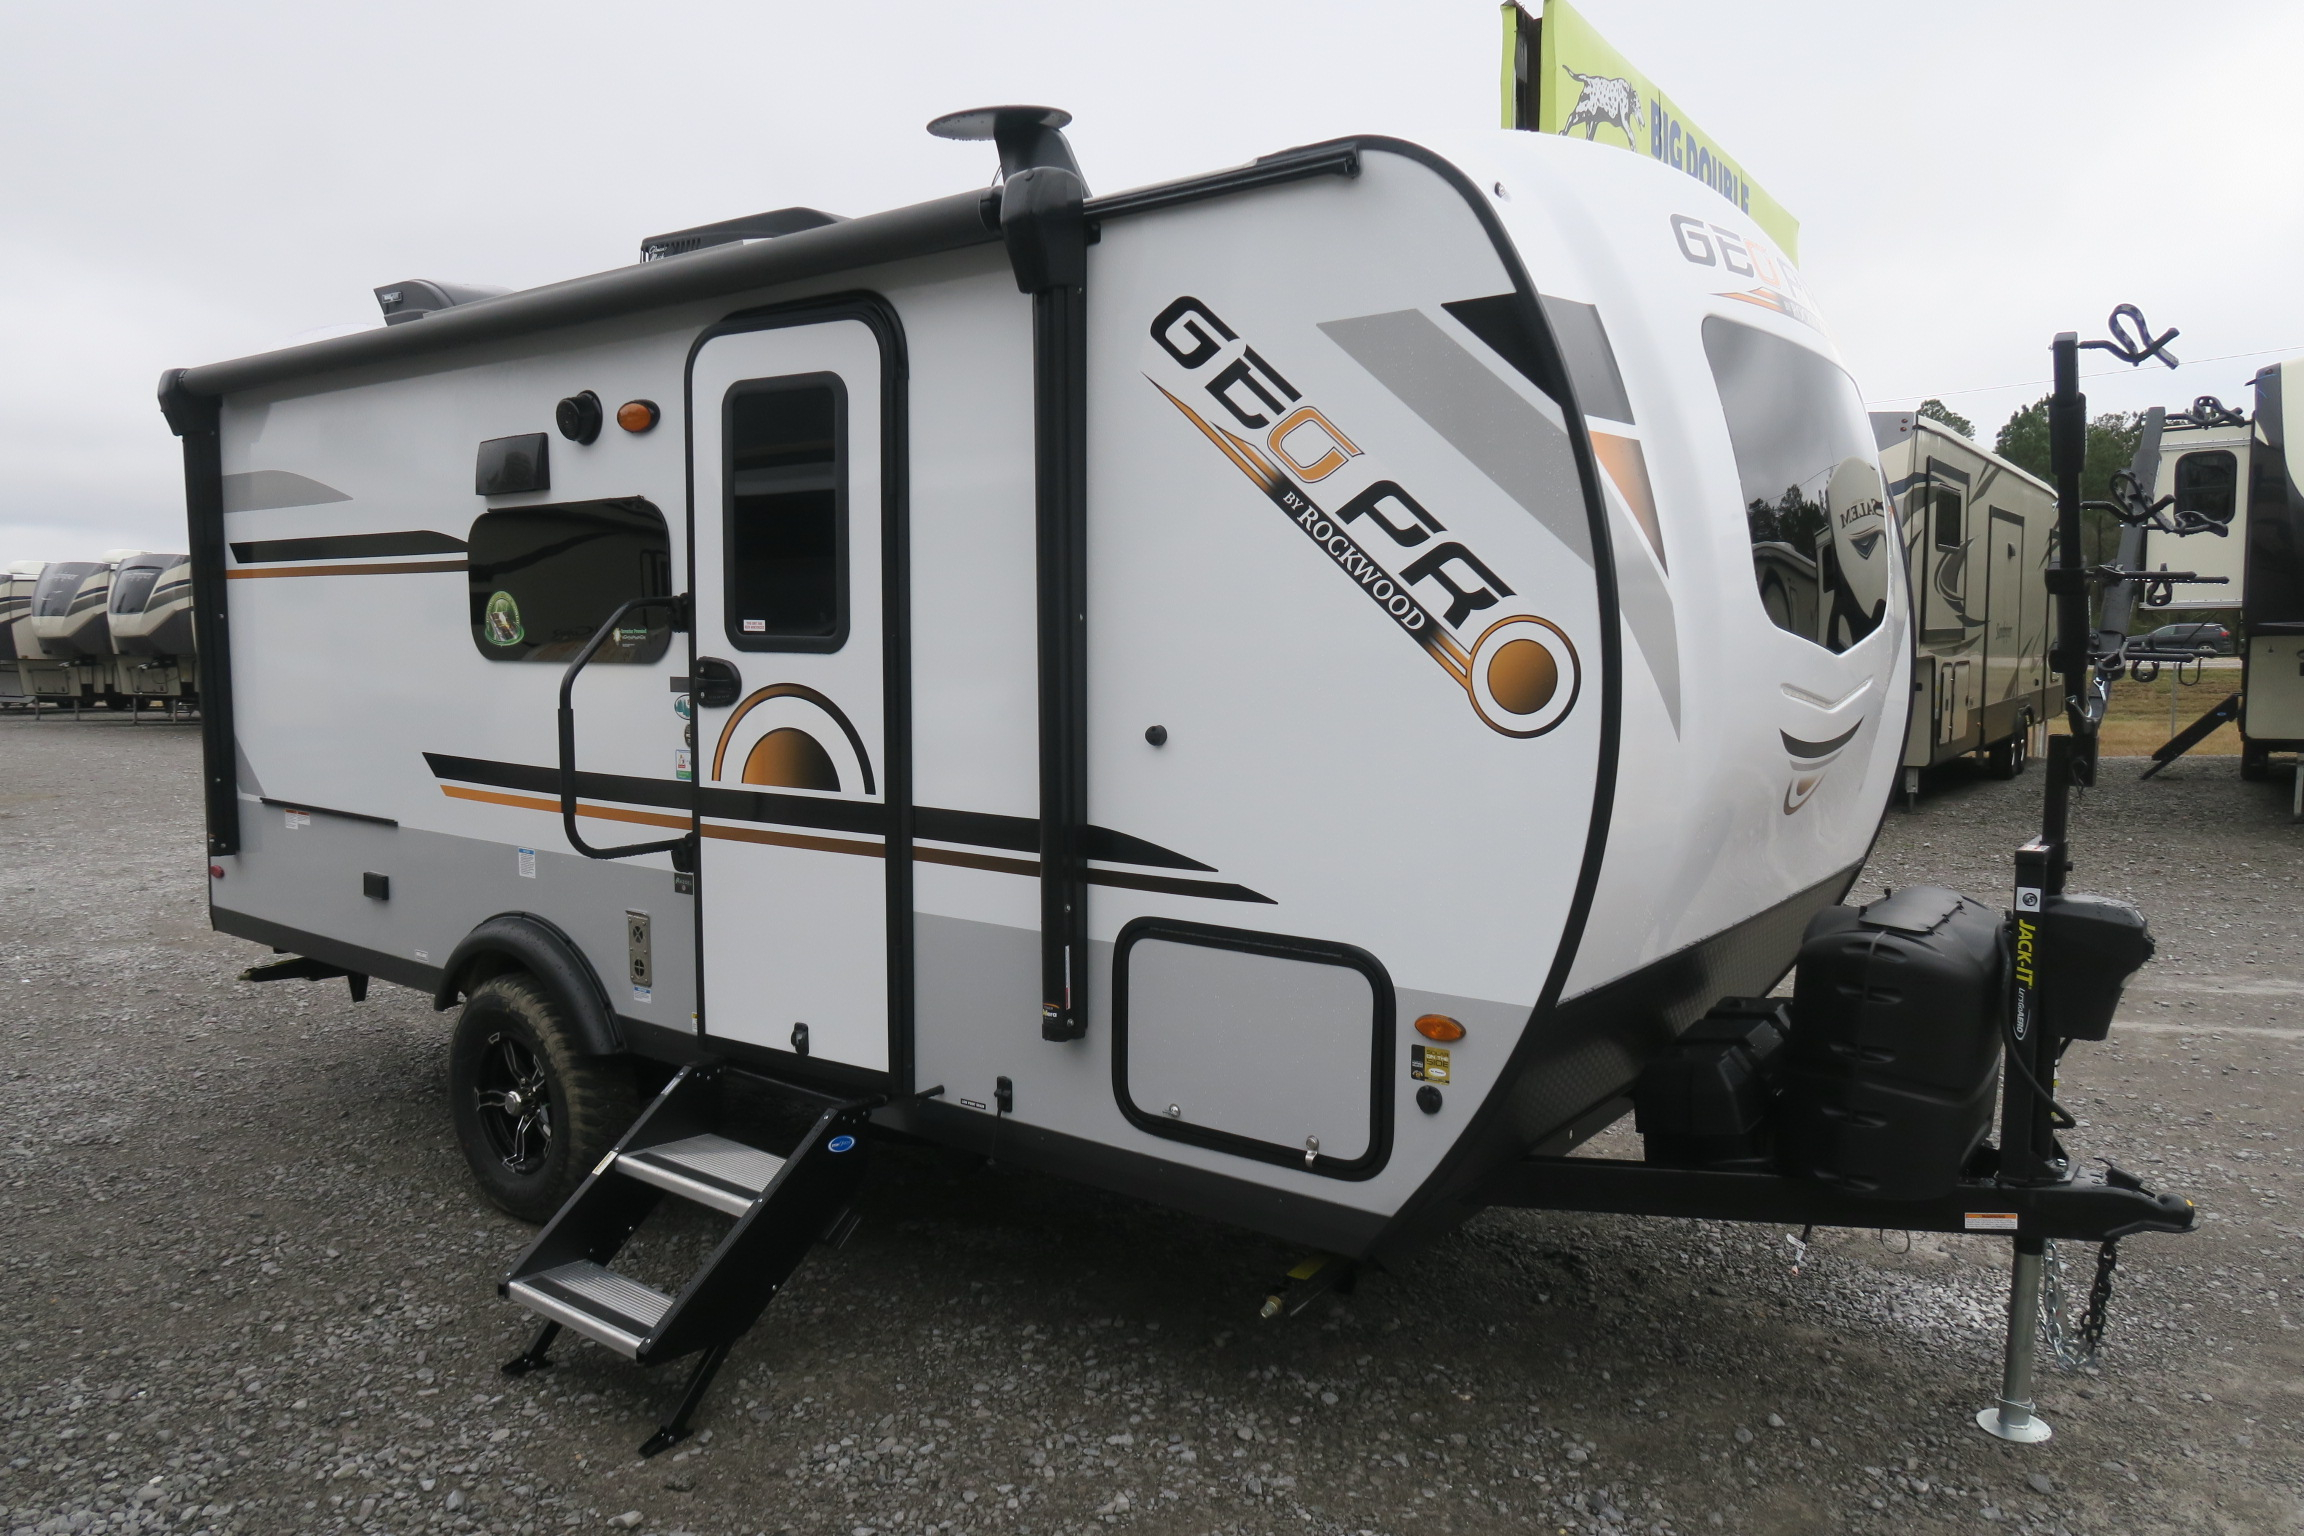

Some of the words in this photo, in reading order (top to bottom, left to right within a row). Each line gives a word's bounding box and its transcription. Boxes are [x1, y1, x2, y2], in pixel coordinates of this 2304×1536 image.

[1651, 98, 1683, 171] BIG
[1670, 213, 1781, 288] GEO
[1150, 295, 1365, 484] GEO
[1283, 491, 1303, 512] BY
[1298, 506, 1426, 634] ROCKWOOD
[2015, 918, 2036, 988] JACK-IT
[1426, 1058, 1449, 1068] SIDE
